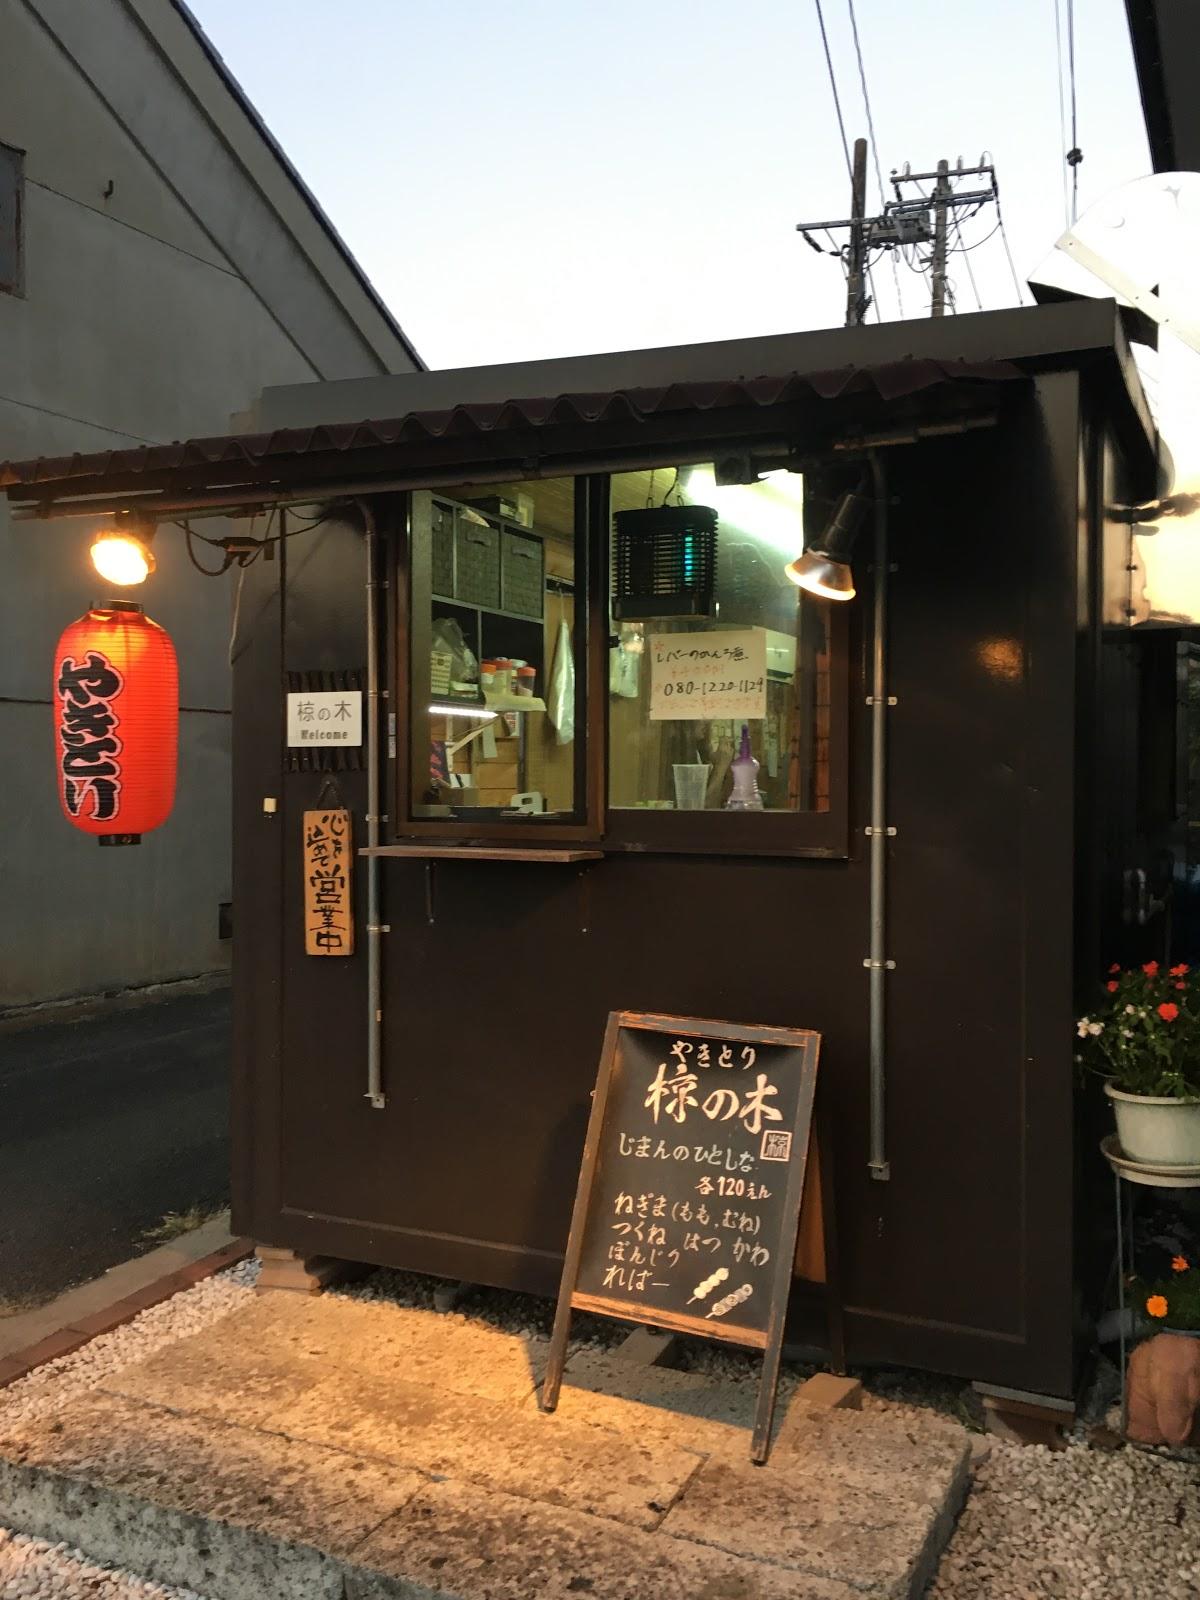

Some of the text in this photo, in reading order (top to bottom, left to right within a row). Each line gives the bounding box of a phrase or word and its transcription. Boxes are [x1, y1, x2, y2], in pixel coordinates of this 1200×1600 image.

[297, 700, 352, 722] 椋の木
[58, 651, 123, 820] やきとり
[301, 729, 348, 740] Welcome
[310, 864, 346, 953] 営業中
[670, 1040, 756, 1069] やきとり
[644, 1063, 783, 1134] 椋の木
[619, 1132, 756, 1172] じまんのひとしな
[611, 1222, 770, 1267] つくね はつ かわ
[602, 1265, 670, 1291] ればー
